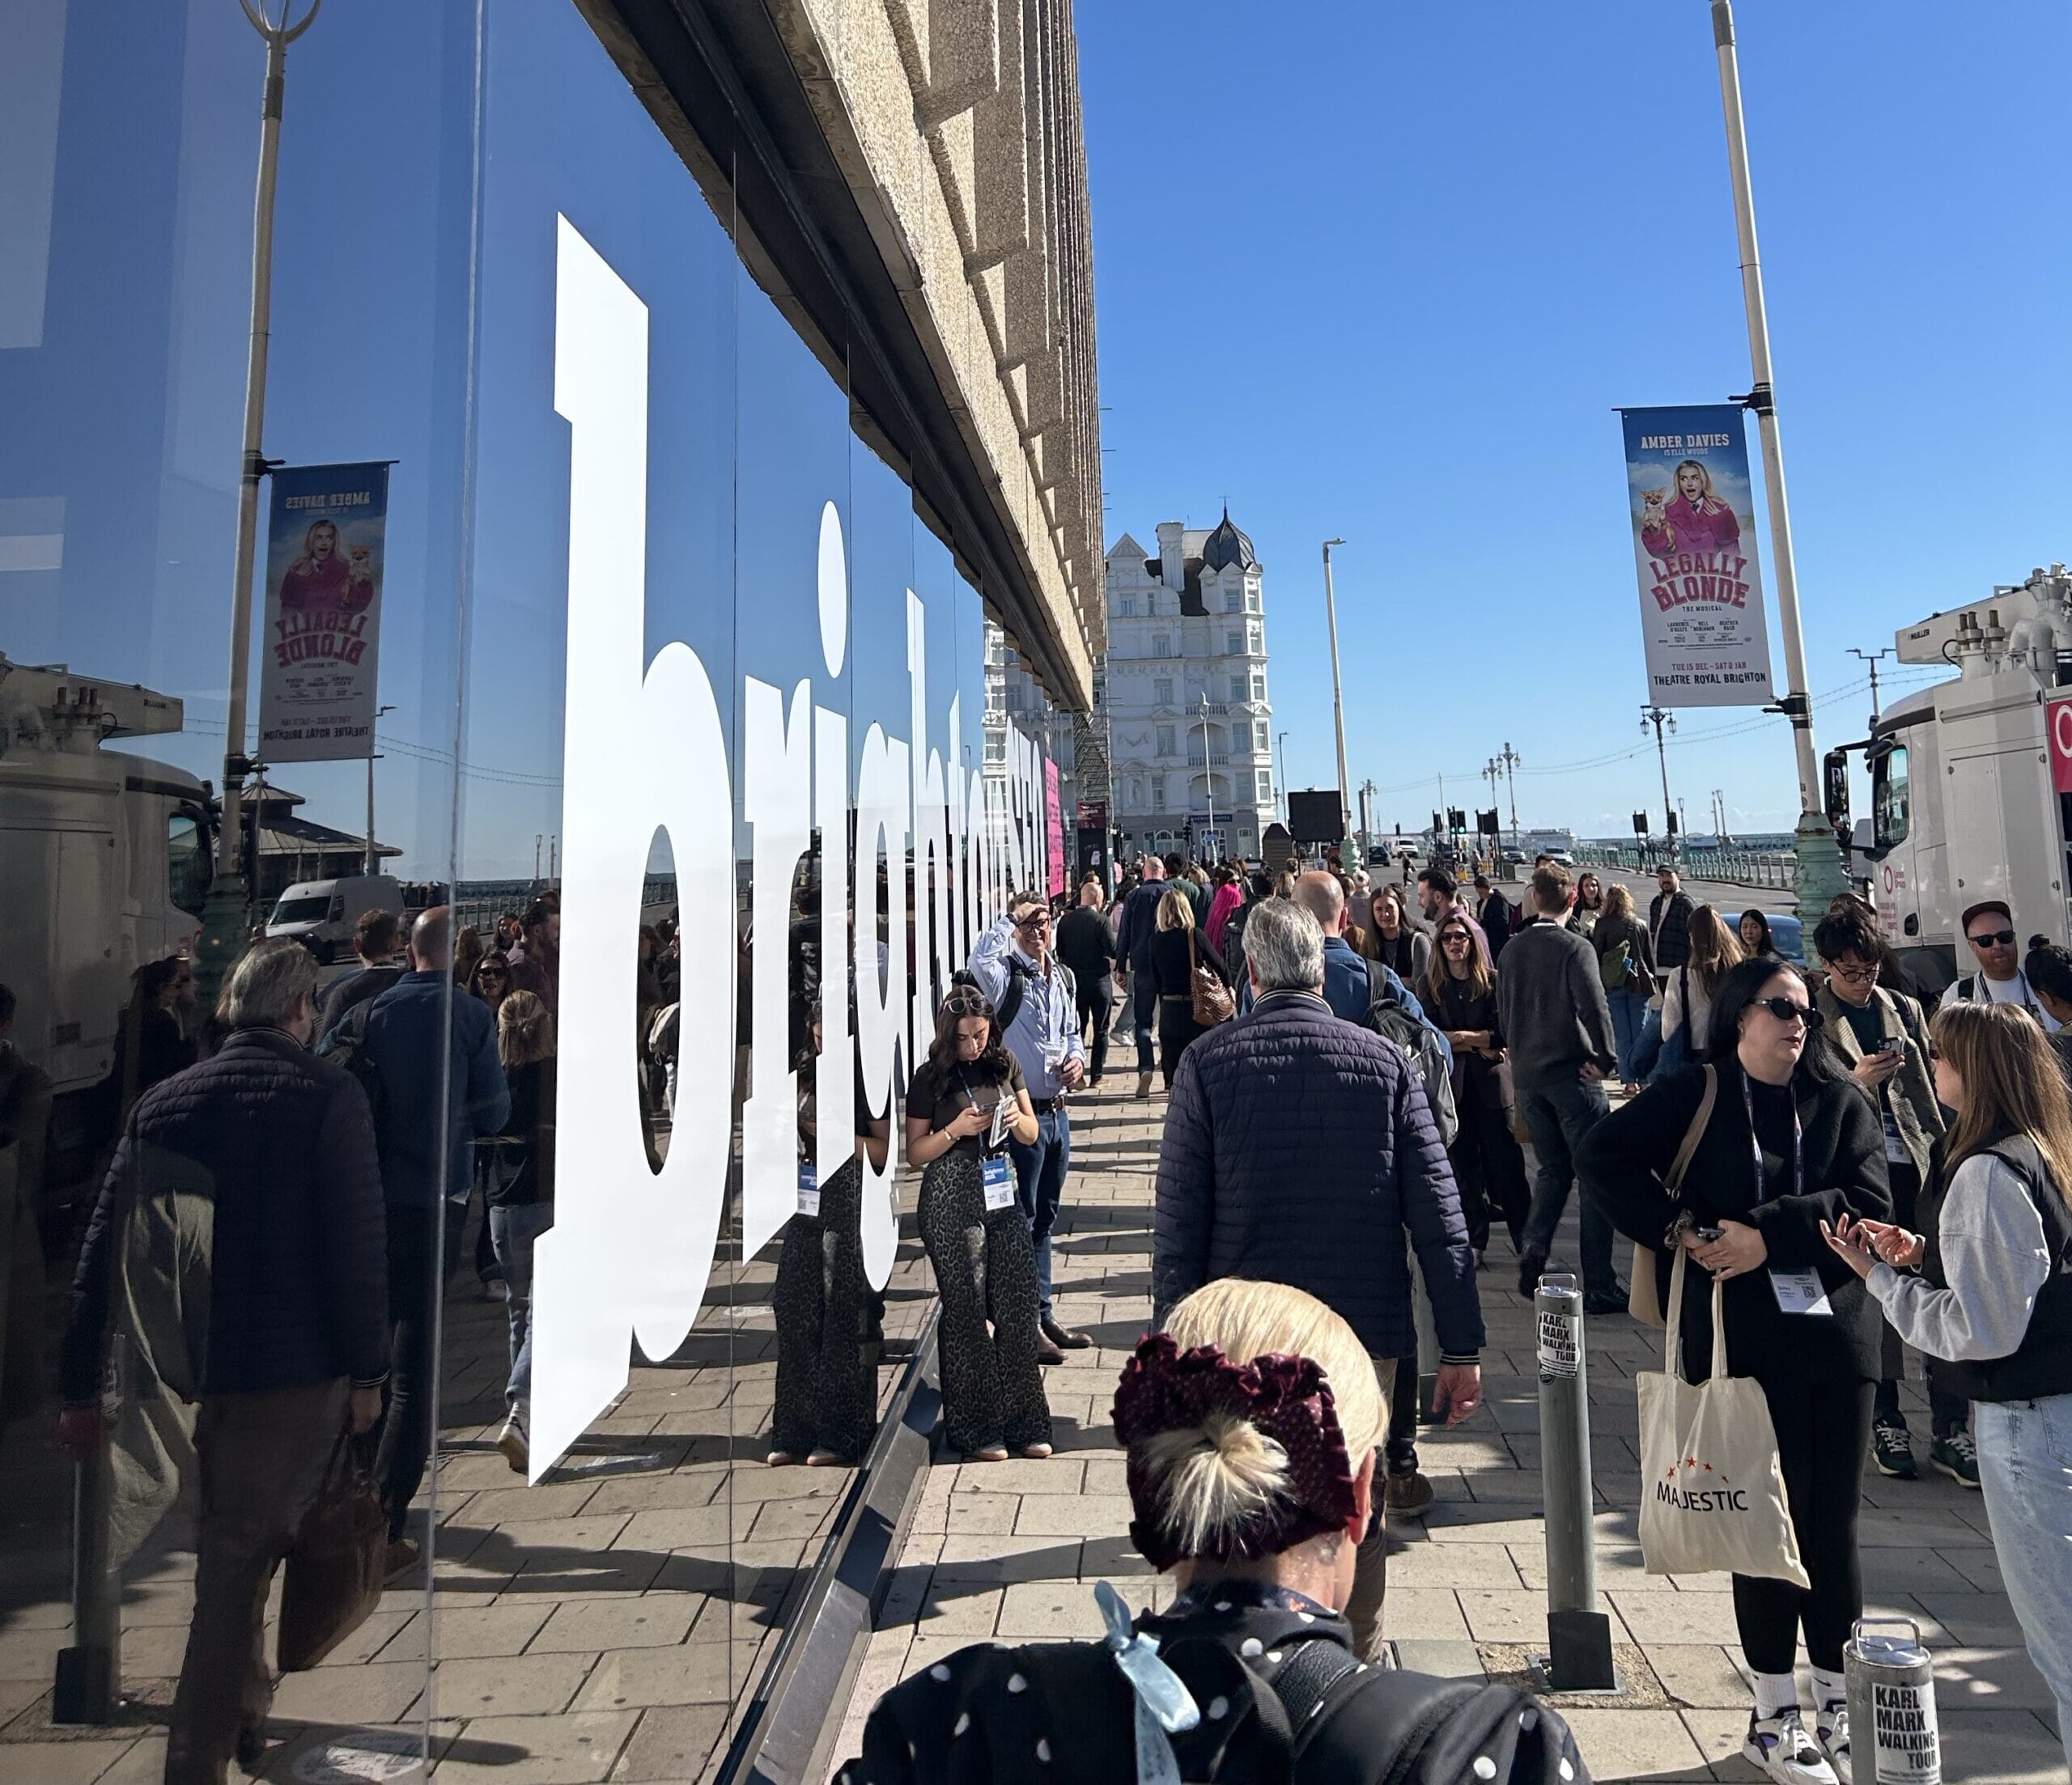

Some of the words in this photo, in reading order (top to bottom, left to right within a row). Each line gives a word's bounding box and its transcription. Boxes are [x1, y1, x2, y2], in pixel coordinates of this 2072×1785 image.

[1641, 435, 1683, 449] AMBER
[1687, 434, 1730, 447] DAVIES
[1687, 447, 1709, 456] WOODS
[1649, 552, 1747, 583] LEGALLY
[1650, 575, 1750, 613] BLONDE
[1686, 663, 1693, 671] 15
[1715, 662, 1727, 670] SAT
[1734, 661, 1747, 669] JAN
[1654, 675, 1691, 686] THEATRE
[1694, 673, 1722, 685] ROYAL
[1724, 672, 1766, 684] BRIGHTON
[1543, 1312, 1567, 1328] KARL
[1543, 1325, 1569, 1341] MARX
[1543, 1336, 1576, 1351] WALKING
[1556, 1350, 1576, 1362] TOUR
[1658, 1480, 1748, 1512] MAJESTIC
[1875, 1685, 1921, 1709] KARL
[1878, 1730, 1935, 1749] WALKING
[1908, 1749, 1937, 1769] TOUR
